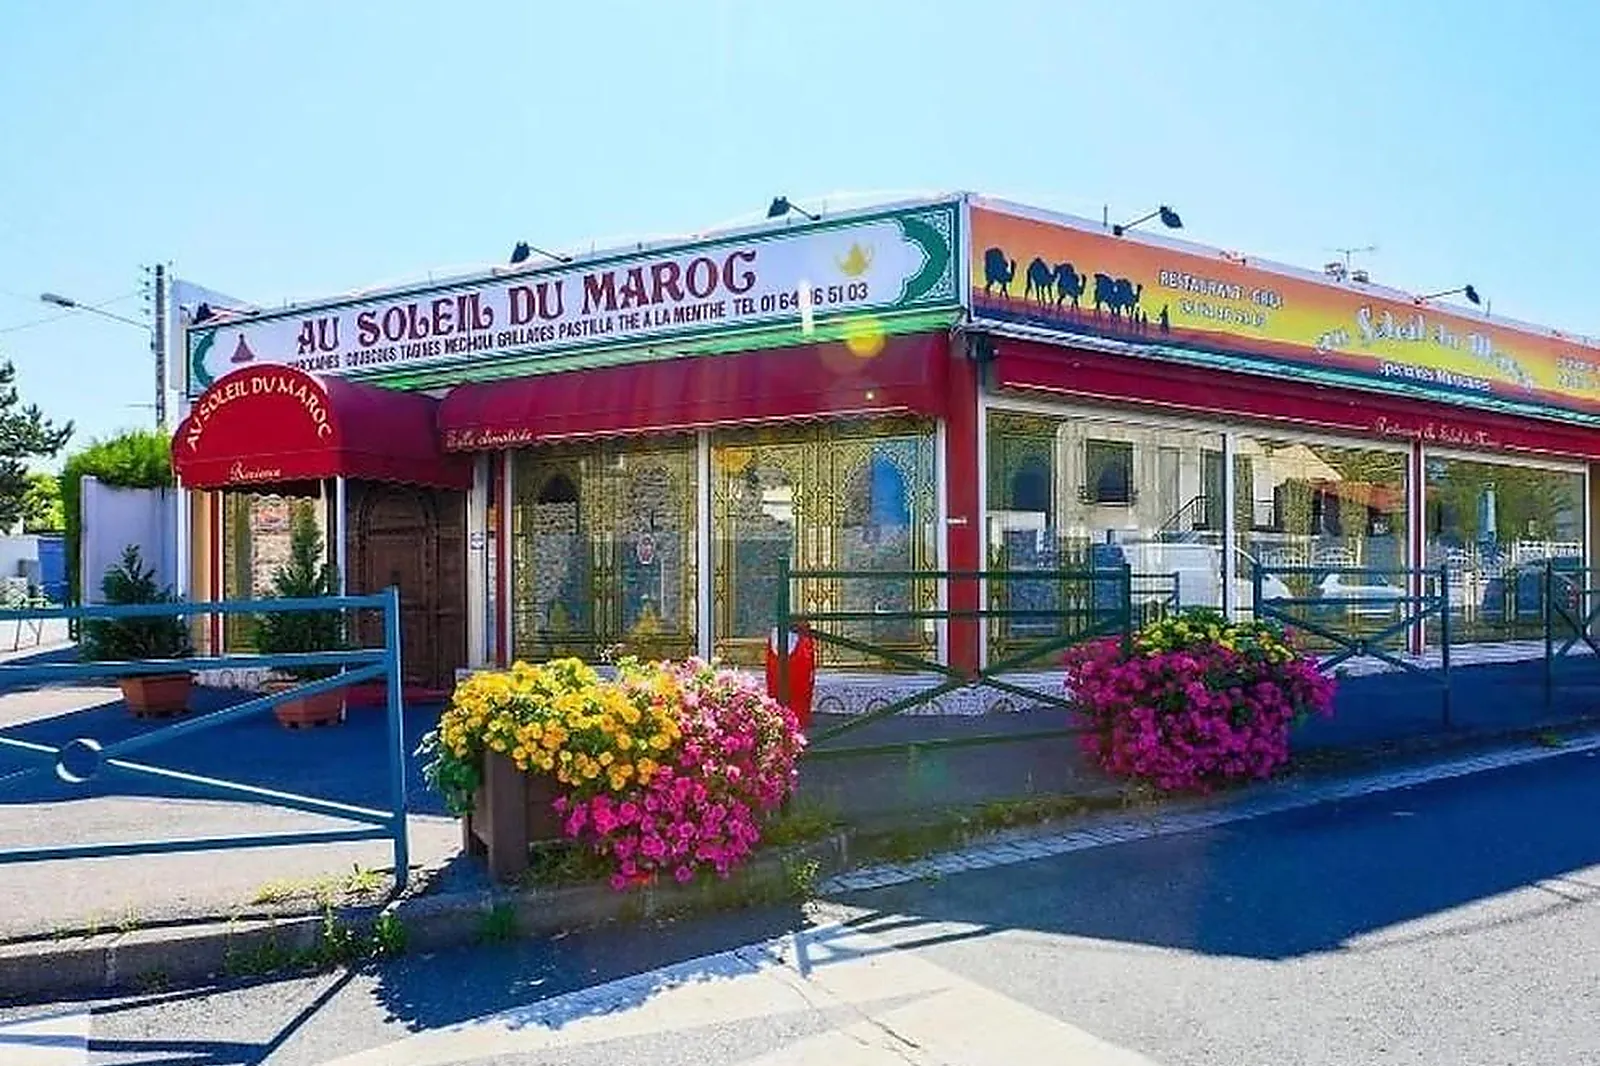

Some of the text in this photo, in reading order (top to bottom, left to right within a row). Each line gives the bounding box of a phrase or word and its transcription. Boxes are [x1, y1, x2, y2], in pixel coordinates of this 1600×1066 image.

[298, 250, 757, 355] AU SOLEIL DU MAROC
[497, 324, 555, 348] GRILLADES
[559, 315, 614, 339] PASTILLA
[618, 310, 640, 331] THE
[643, 310, 653, 328] A
[655, 307, 671, 326] LA
[674, 300, 726, 325] MENTHE
[733, 297, 756, 315] TEL
[761, 293, 776, 312] 01
[780, 290, 799, 310] 64
[828, 285, 844, 304] 51
[848, 282, 868, 301] 03
[186, 376, 333, 454] AU SOLEIL DU MAROC
